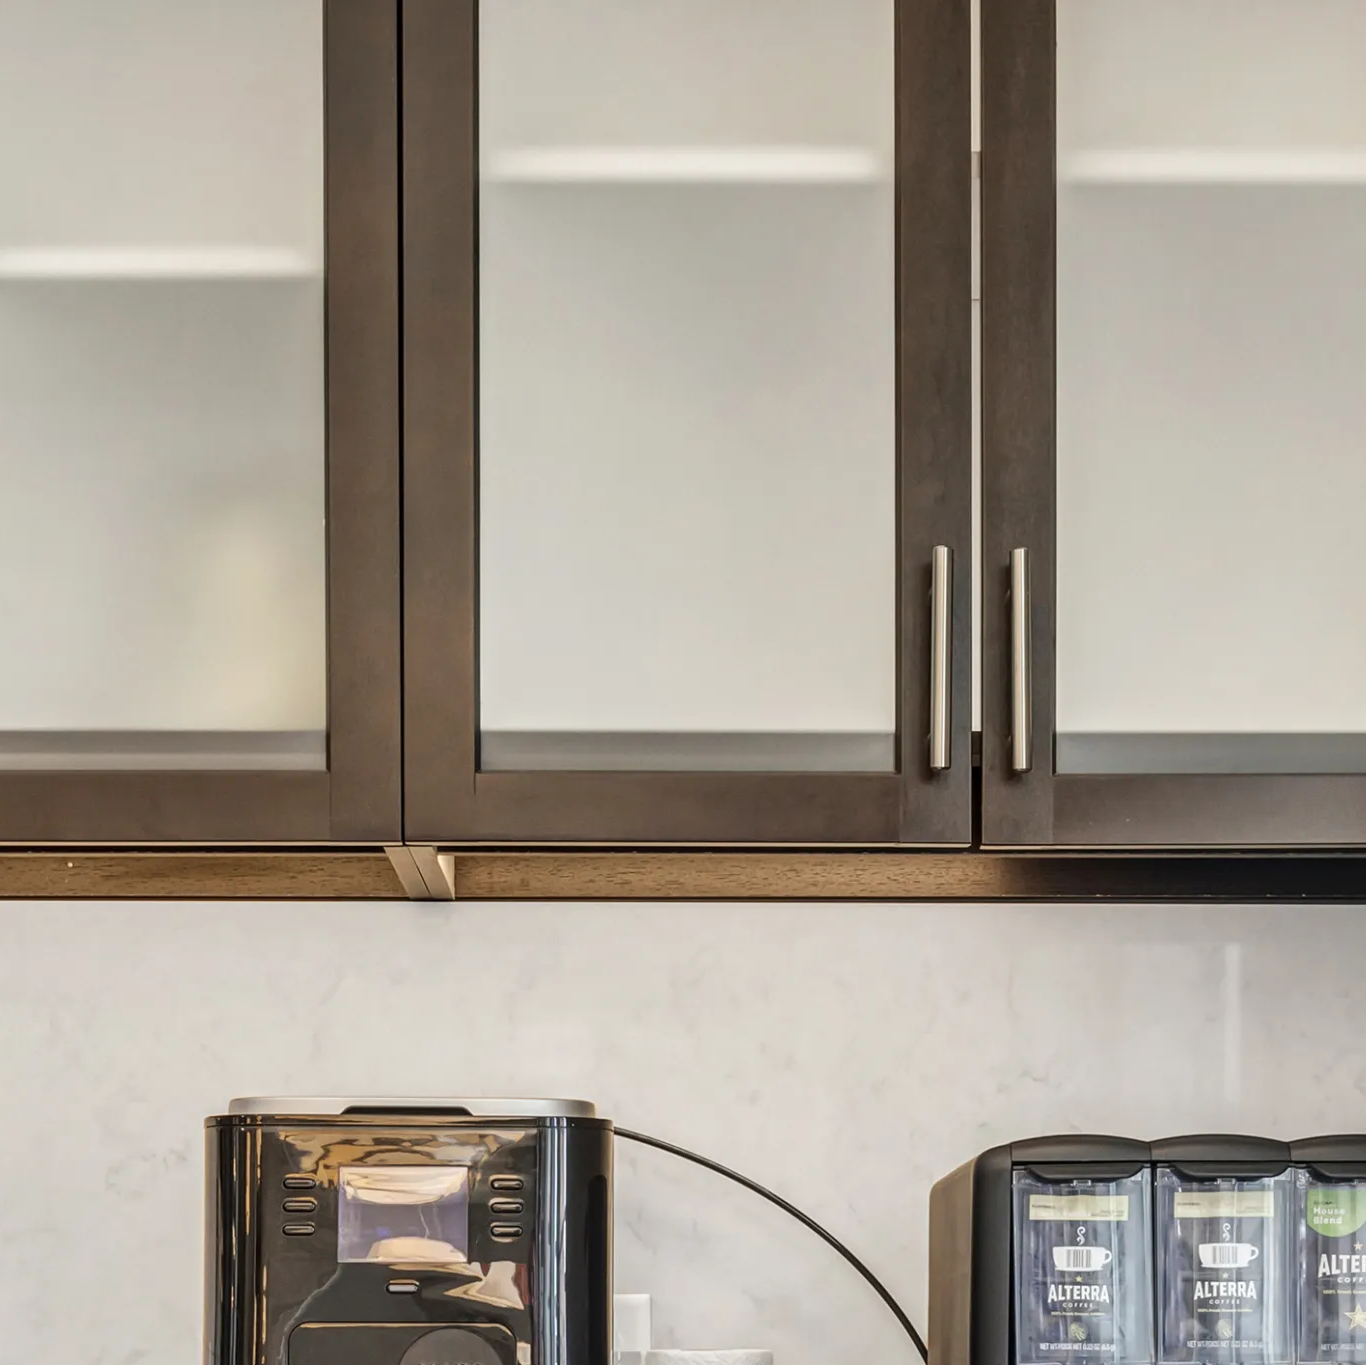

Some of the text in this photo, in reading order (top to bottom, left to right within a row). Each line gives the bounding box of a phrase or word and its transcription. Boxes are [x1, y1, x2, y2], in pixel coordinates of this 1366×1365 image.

[1313, 1216, 1342, 1224] Blend
[1047, 1284, 1109, 1303] ALTERRA
[1194, 1280, 1257, 1300] ALTERRA
